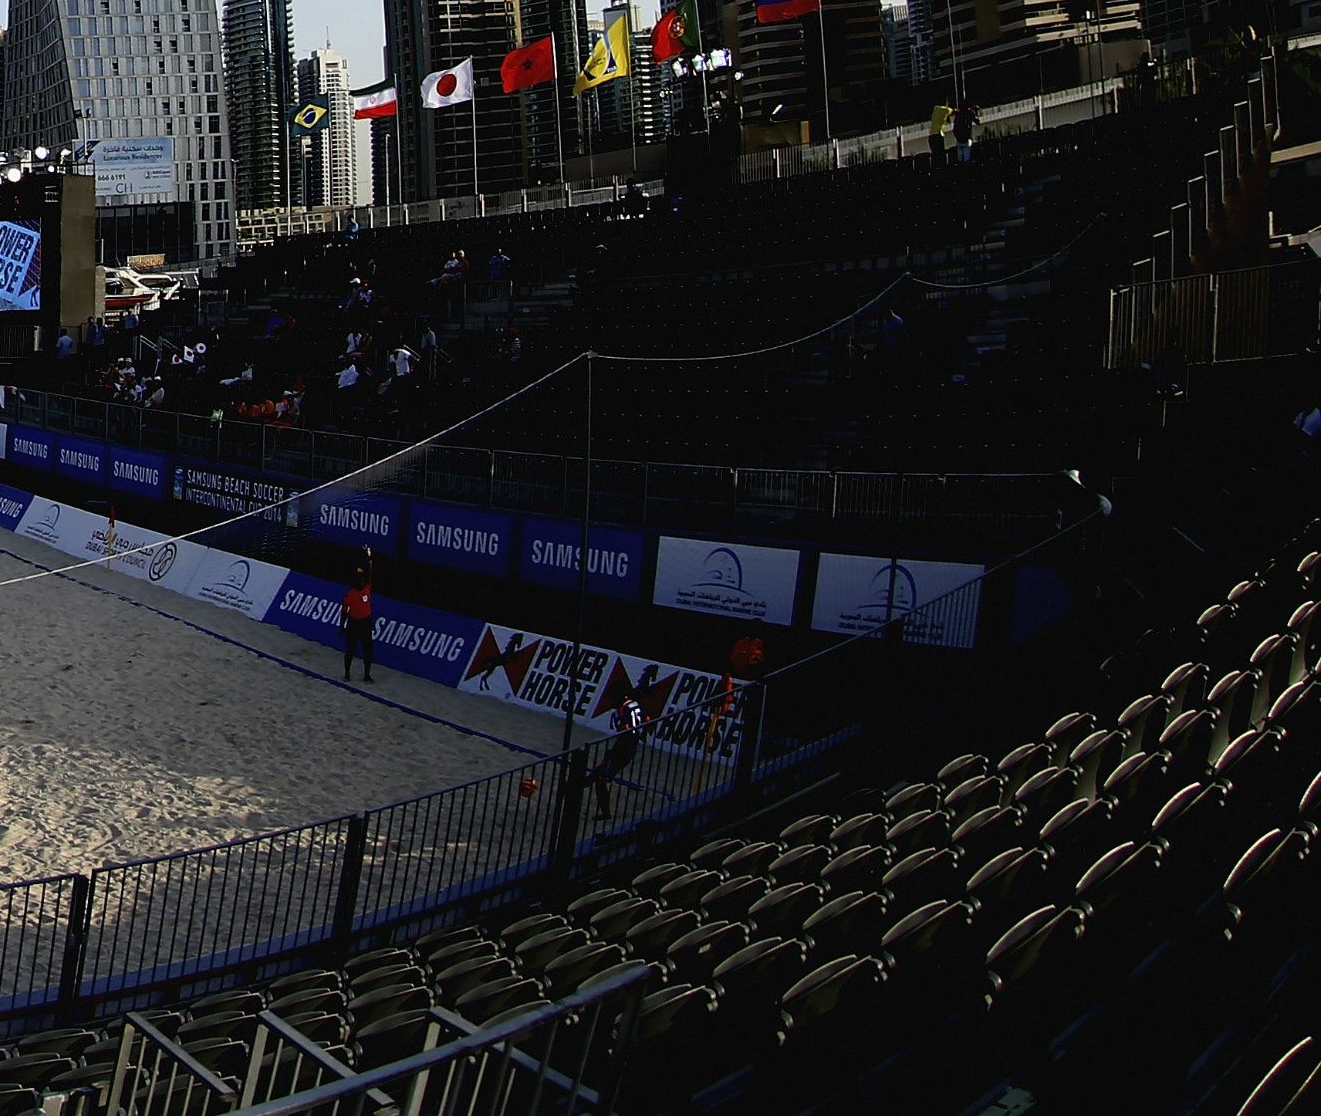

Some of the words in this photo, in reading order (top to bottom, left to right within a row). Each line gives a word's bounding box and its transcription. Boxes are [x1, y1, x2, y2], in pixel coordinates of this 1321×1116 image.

[13, 437, 48, 459] SAMSUNG
[60, 448, 99, 471] SAMSUNG
[113, 460, 159, 486] SAMSUNG
[187, 469, 222, 490] SAMSUNG
[224, 476, 250, 496] BEACH
[252, 482, 284, 502] SOCCER
[186, 487, 247, 514] INTERCONTINENTAL
[320, 503, 389, 536] SAMSUNG
[416, 521, 499, 556] SAMSUNG
[532, 539, 629, 578] SAMSUNG
[280, 588, 349, 629] SAMSUN
[372, 616, 465, 662] SAMSUNG
[535, 638, 609, 682] POWER
[520, 670, 597, 717] HORSE
[630, 707, 642, 733] 15
